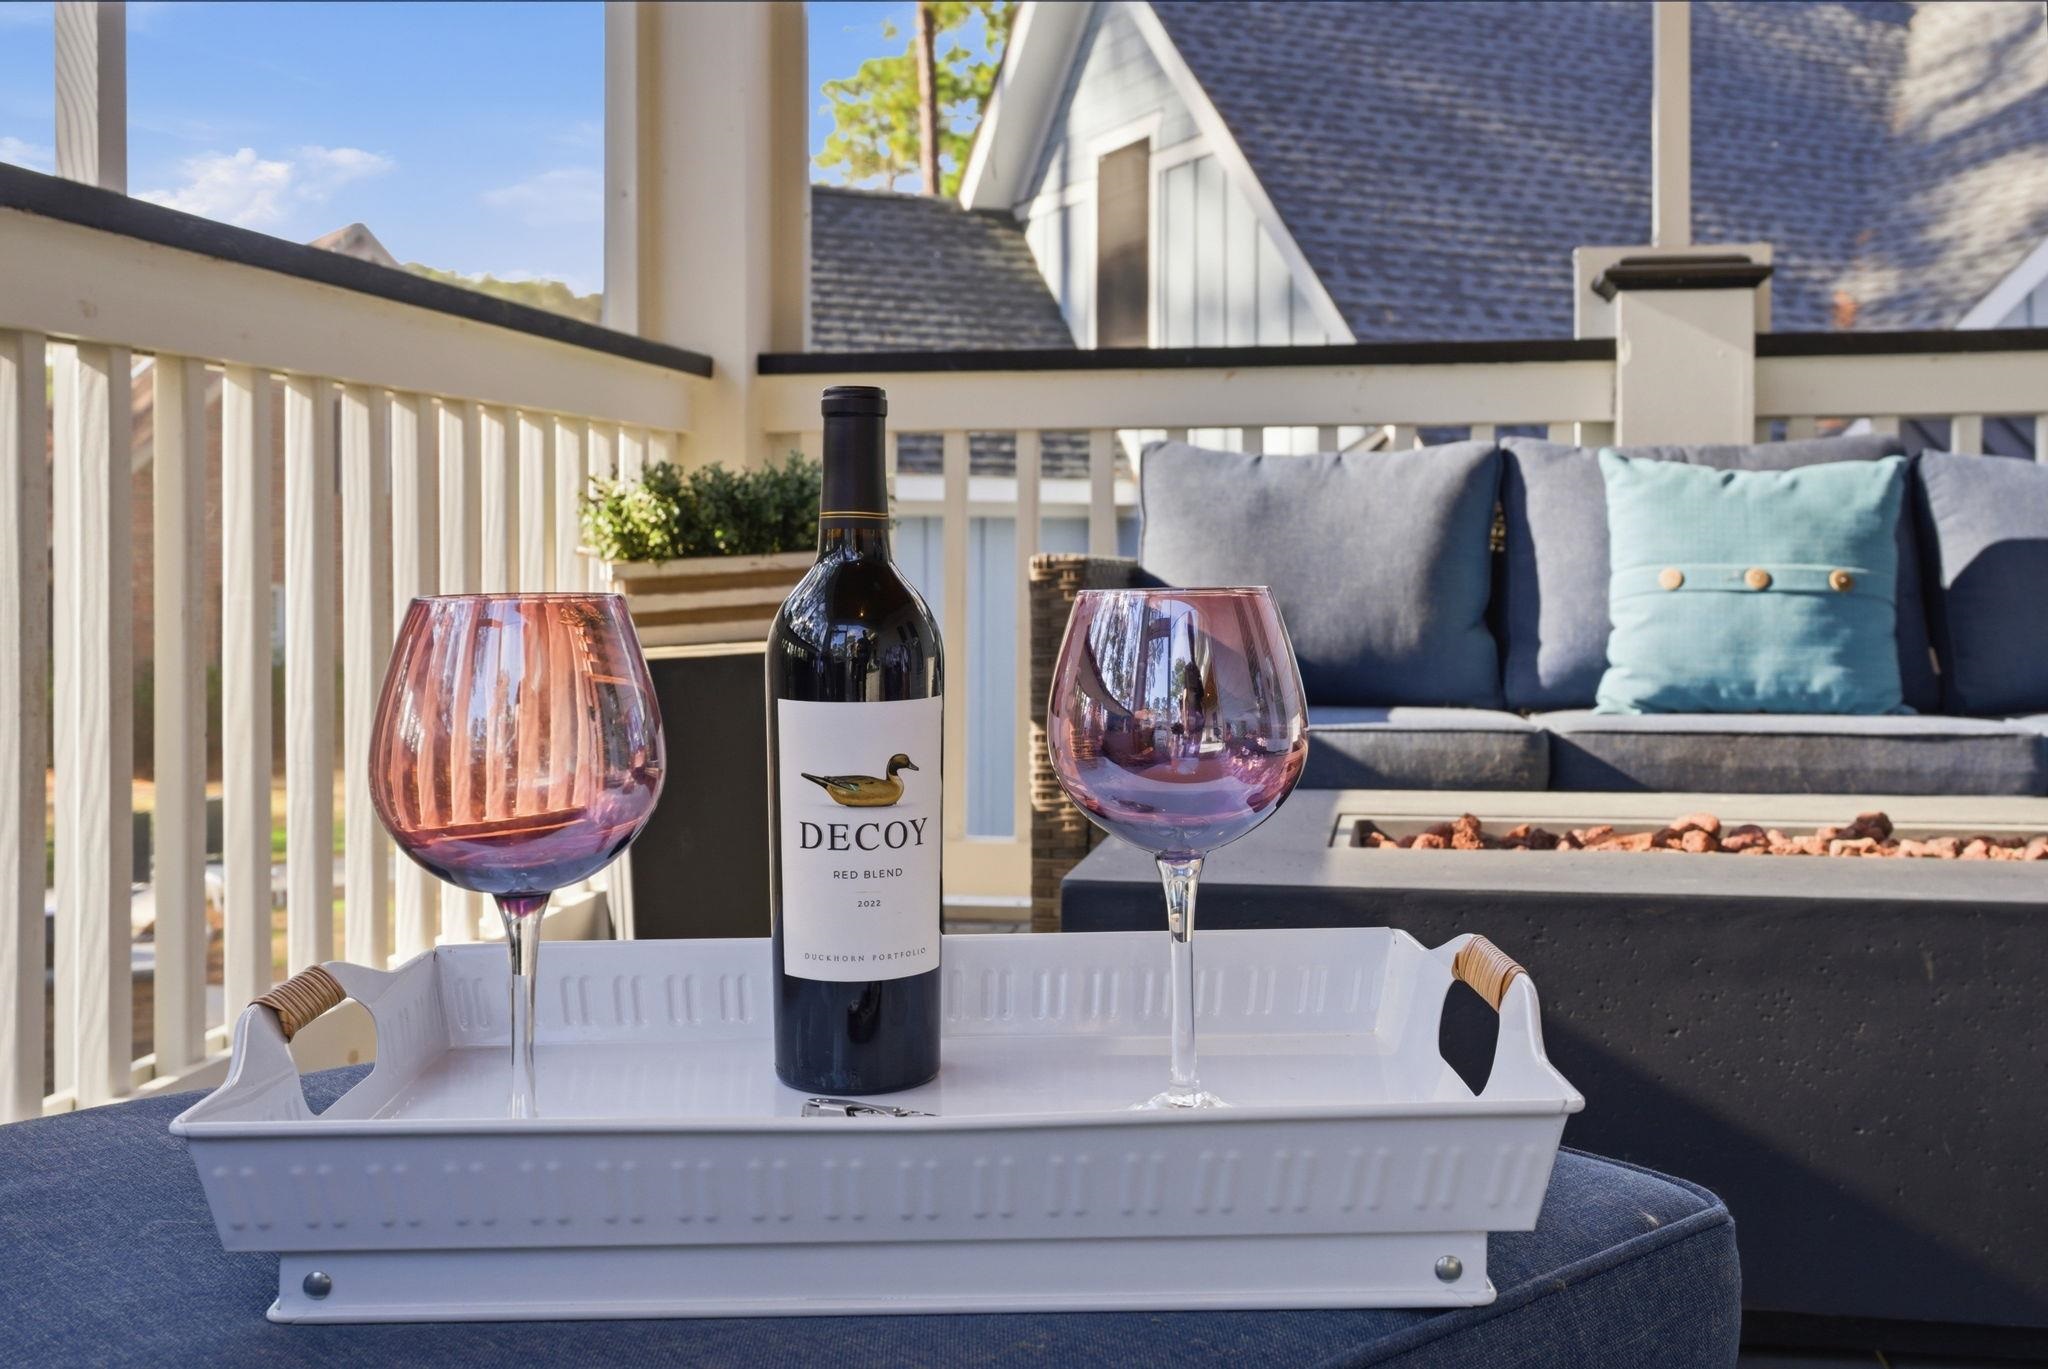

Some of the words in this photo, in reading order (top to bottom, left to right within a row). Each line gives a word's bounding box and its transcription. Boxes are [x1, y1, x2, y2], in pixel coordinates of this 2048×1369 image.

[799, 817, 928, 851] DECOY
[833, 870, 858, 880] RED
[863, 868, 903, 879] BLEND
[857, 900, 881, 908] 2022
[804, 952, 865, 962] DUCKHORN
[872, 947, 926, 961] PORTFOLIO
